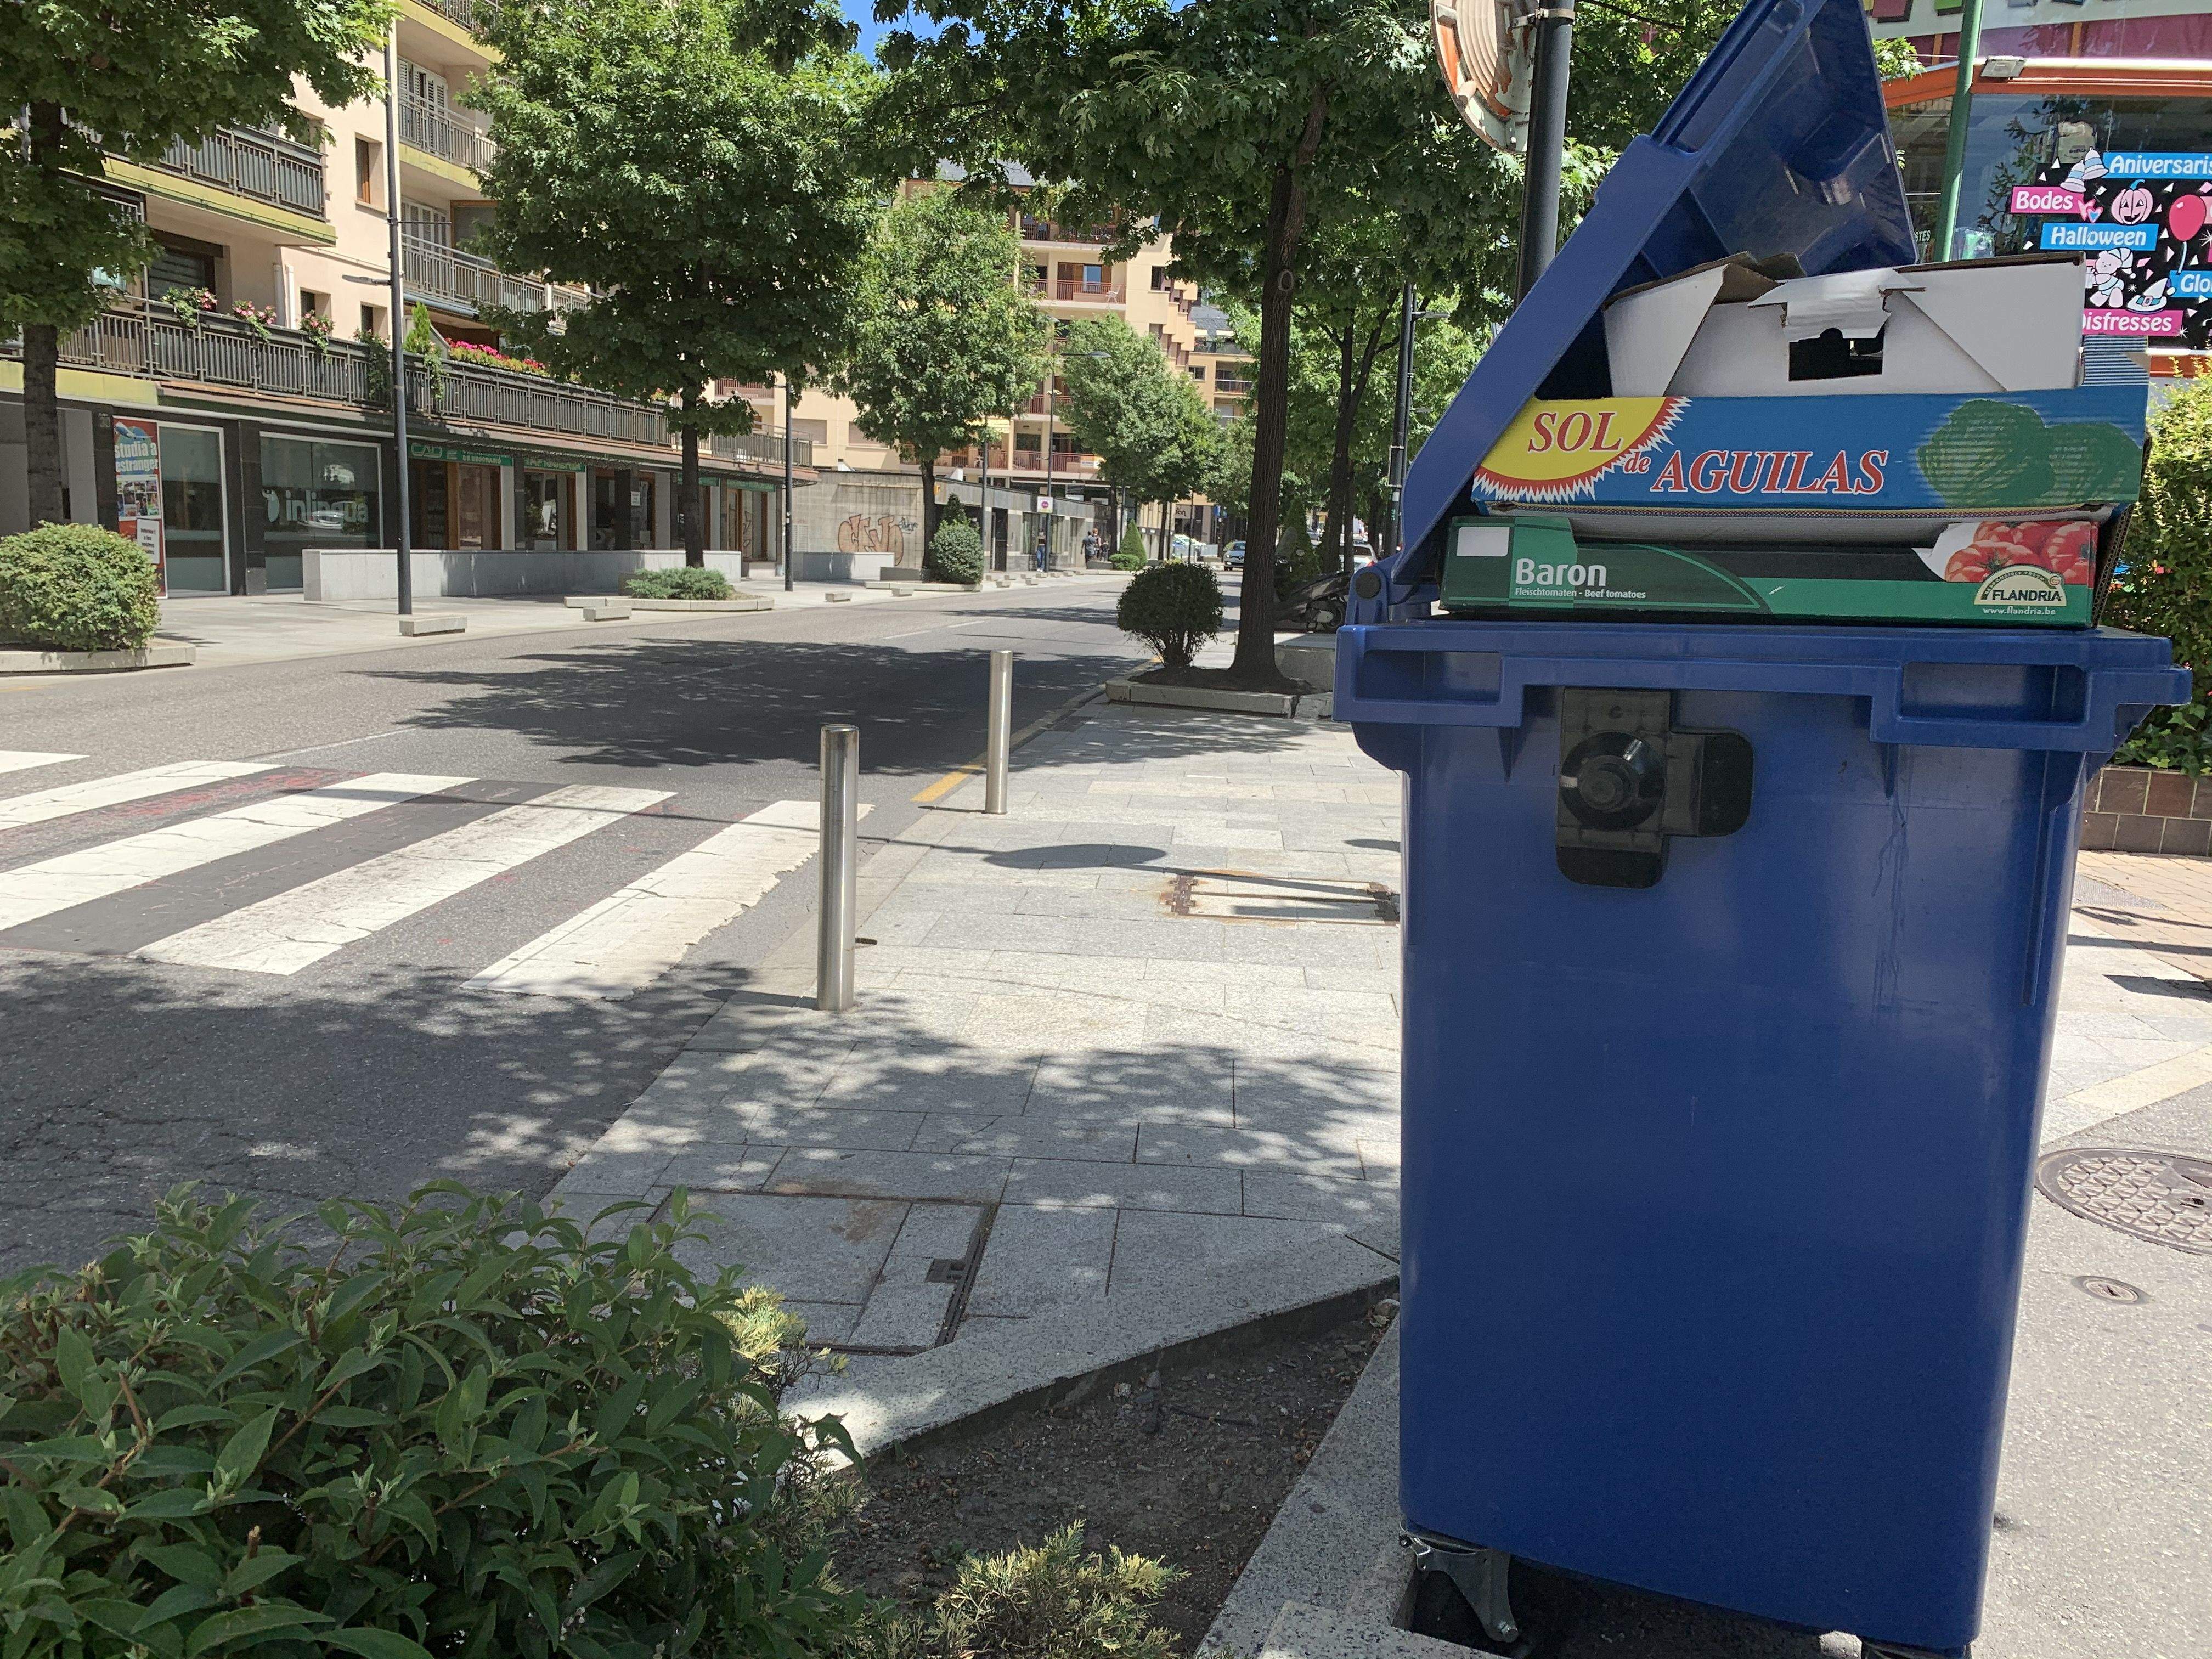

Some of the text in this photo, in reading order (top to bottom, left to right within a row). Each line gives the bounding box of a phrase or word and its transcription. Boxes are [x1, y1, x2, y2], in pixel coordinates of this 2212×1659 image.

[2016, 190, 2073, 210] Bodes
[2051, 226, 2147, 246] Halloween
[1528, 411, 1623, 453] SOL
[1623, 450, 1651, 475] de
[1650, 450, 1889, 494] AGUILAS
[1515, 558, 1607, 586] Baron
[1515, 587, 1577, 597] Fleischtomaten
[1584, 589, 1604, 598] Beef
[1606, 590, 1646, 599] tomatoes
[1992, 589, 2063, 601] FLANDRIA
[1983, 606, 2056, 615] www.flandria.be
